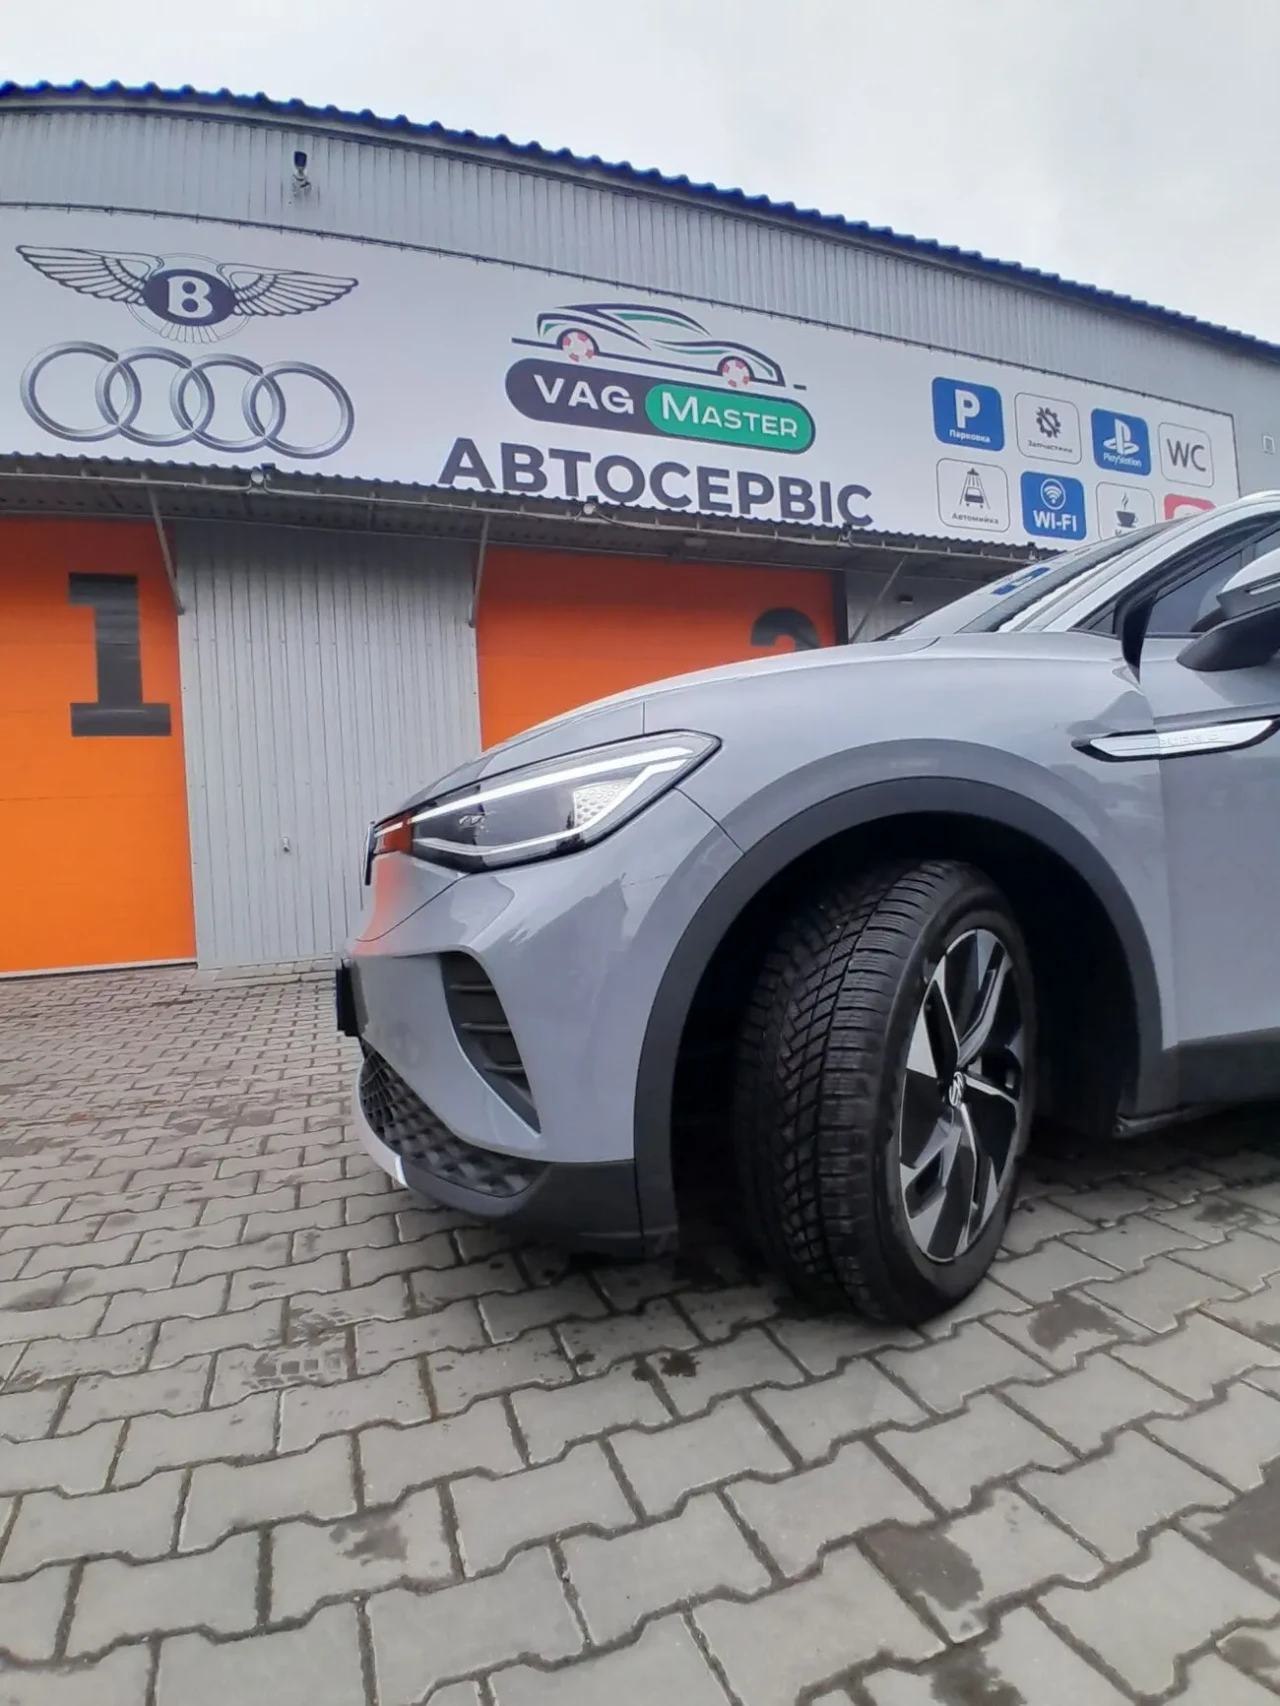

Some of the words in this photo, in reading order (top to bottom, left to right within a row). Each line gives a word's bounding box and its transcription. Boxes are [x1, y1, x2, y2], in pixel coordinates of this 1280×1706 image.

[167, 274, 214, 319] B
[532, 374, 635, 415] VAG
[661, 391, 798, 438] MASTER
[954, 389, 981, 430] P
[949, 429, 991, 443] Парковка
[1166, 438, 1206, 472] WC
[438, 437, 874, 527] АВТОСЕРВІС
[951, 512, 999, 525] Автомийка
[1033, 509, 1078, 533] WI-FI
[68, 571, 172, 737] 1
